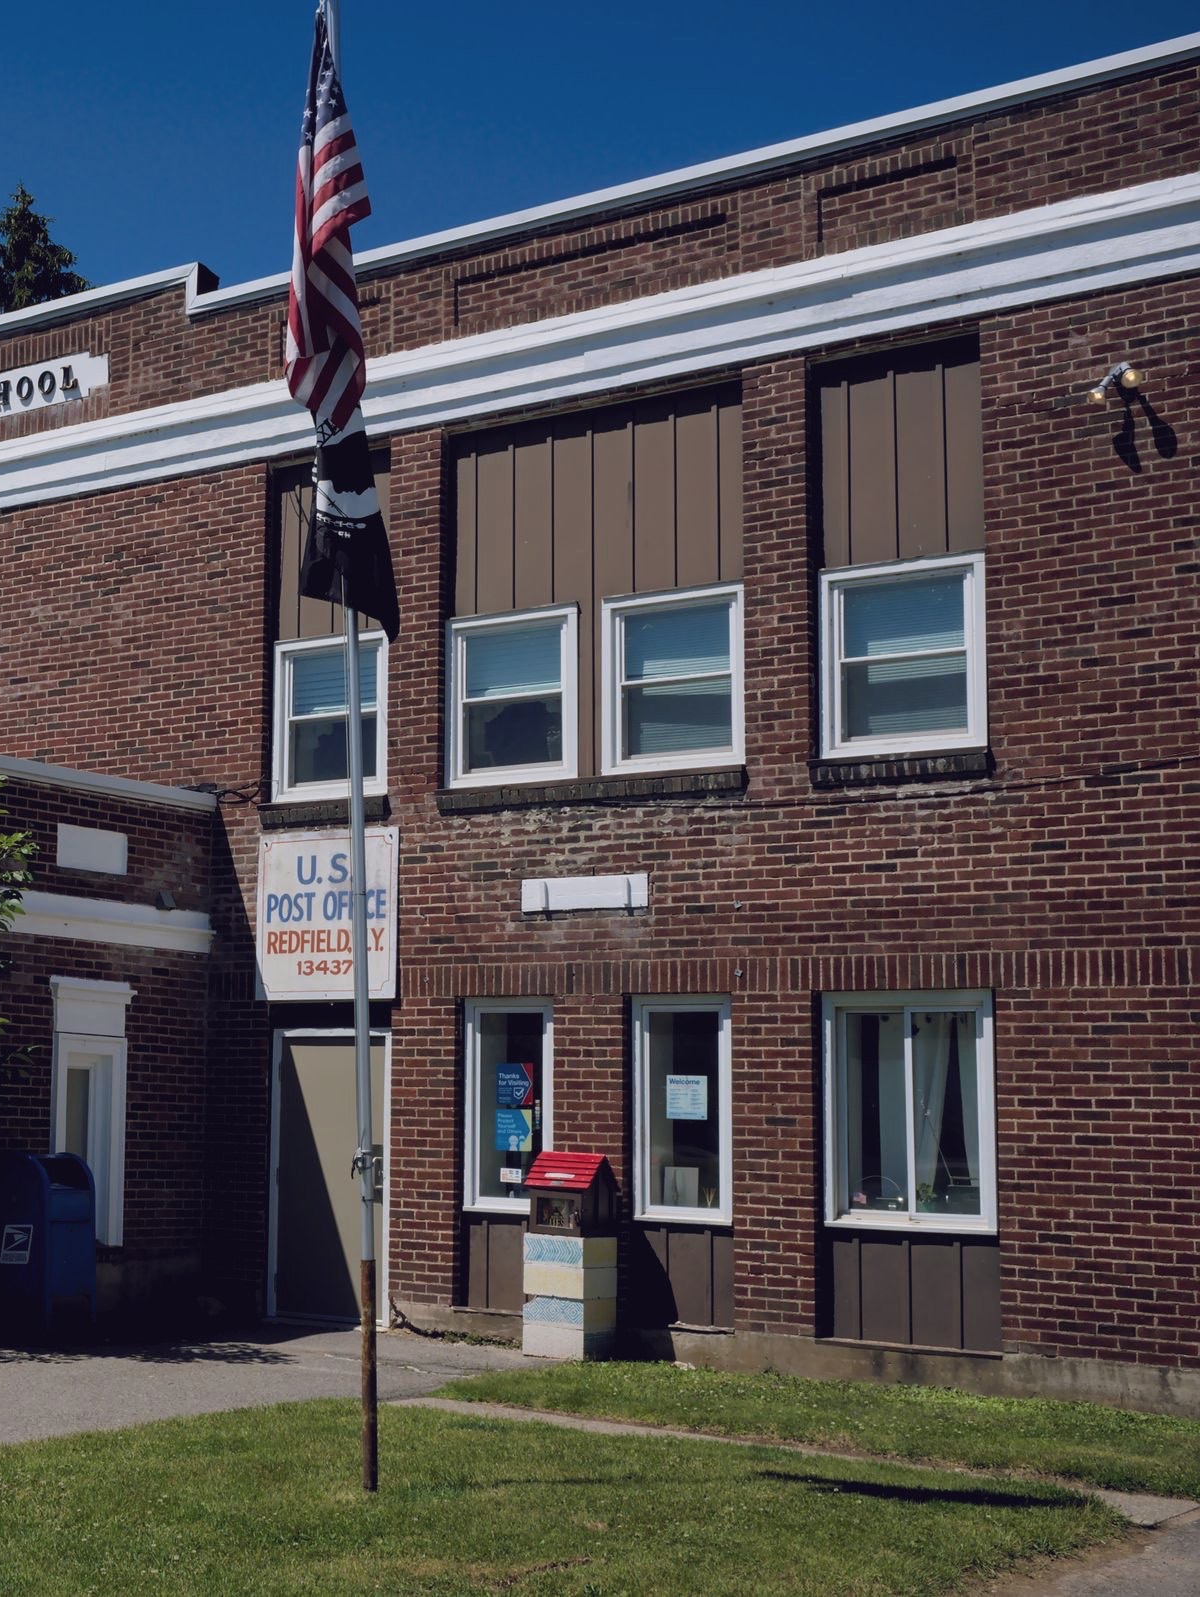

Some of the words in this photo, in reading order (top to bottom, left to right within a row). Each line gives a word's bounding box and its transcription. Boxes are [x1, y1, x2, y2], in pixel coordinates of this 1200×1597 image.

[297, 852, 352, 885] U.S
[266, 891, 316, 924] POST
[322, 888, 387, 921] OFCE
[296, 959, 354, 976] 13437
[507, 1079, 530, 1087] Visiting
[669, 1077, 700, 1085] Welcome
